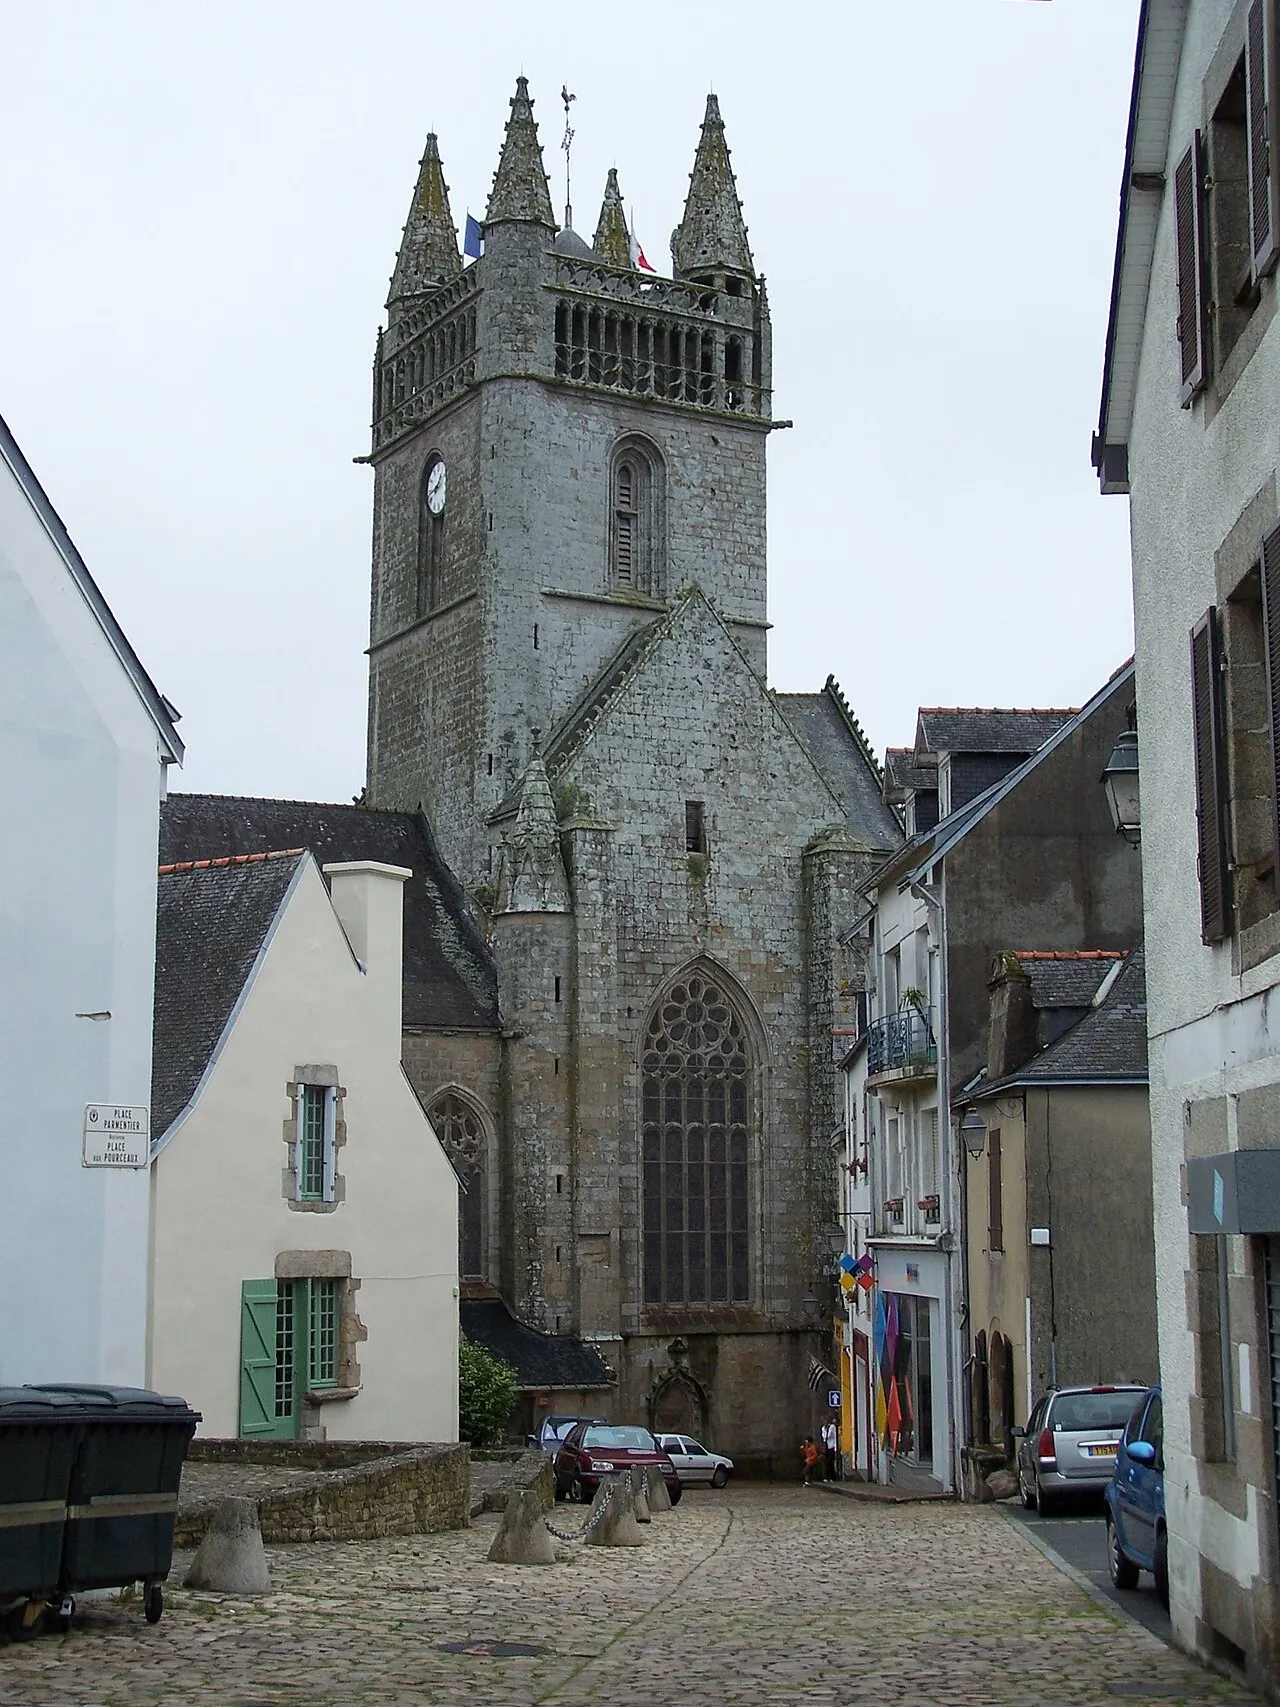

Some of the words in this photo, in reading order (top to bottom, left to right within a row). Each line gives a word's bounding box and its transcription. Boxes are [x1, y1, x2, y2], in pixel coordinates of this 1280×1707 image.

[114, 1109, 132, 1119] PLACE
[104, 1120, 140, 1130] PARMENTIER
[107, 1142, 125, 1152] PLACE
[104, 1153, 138, 1163] POURCEAUX
